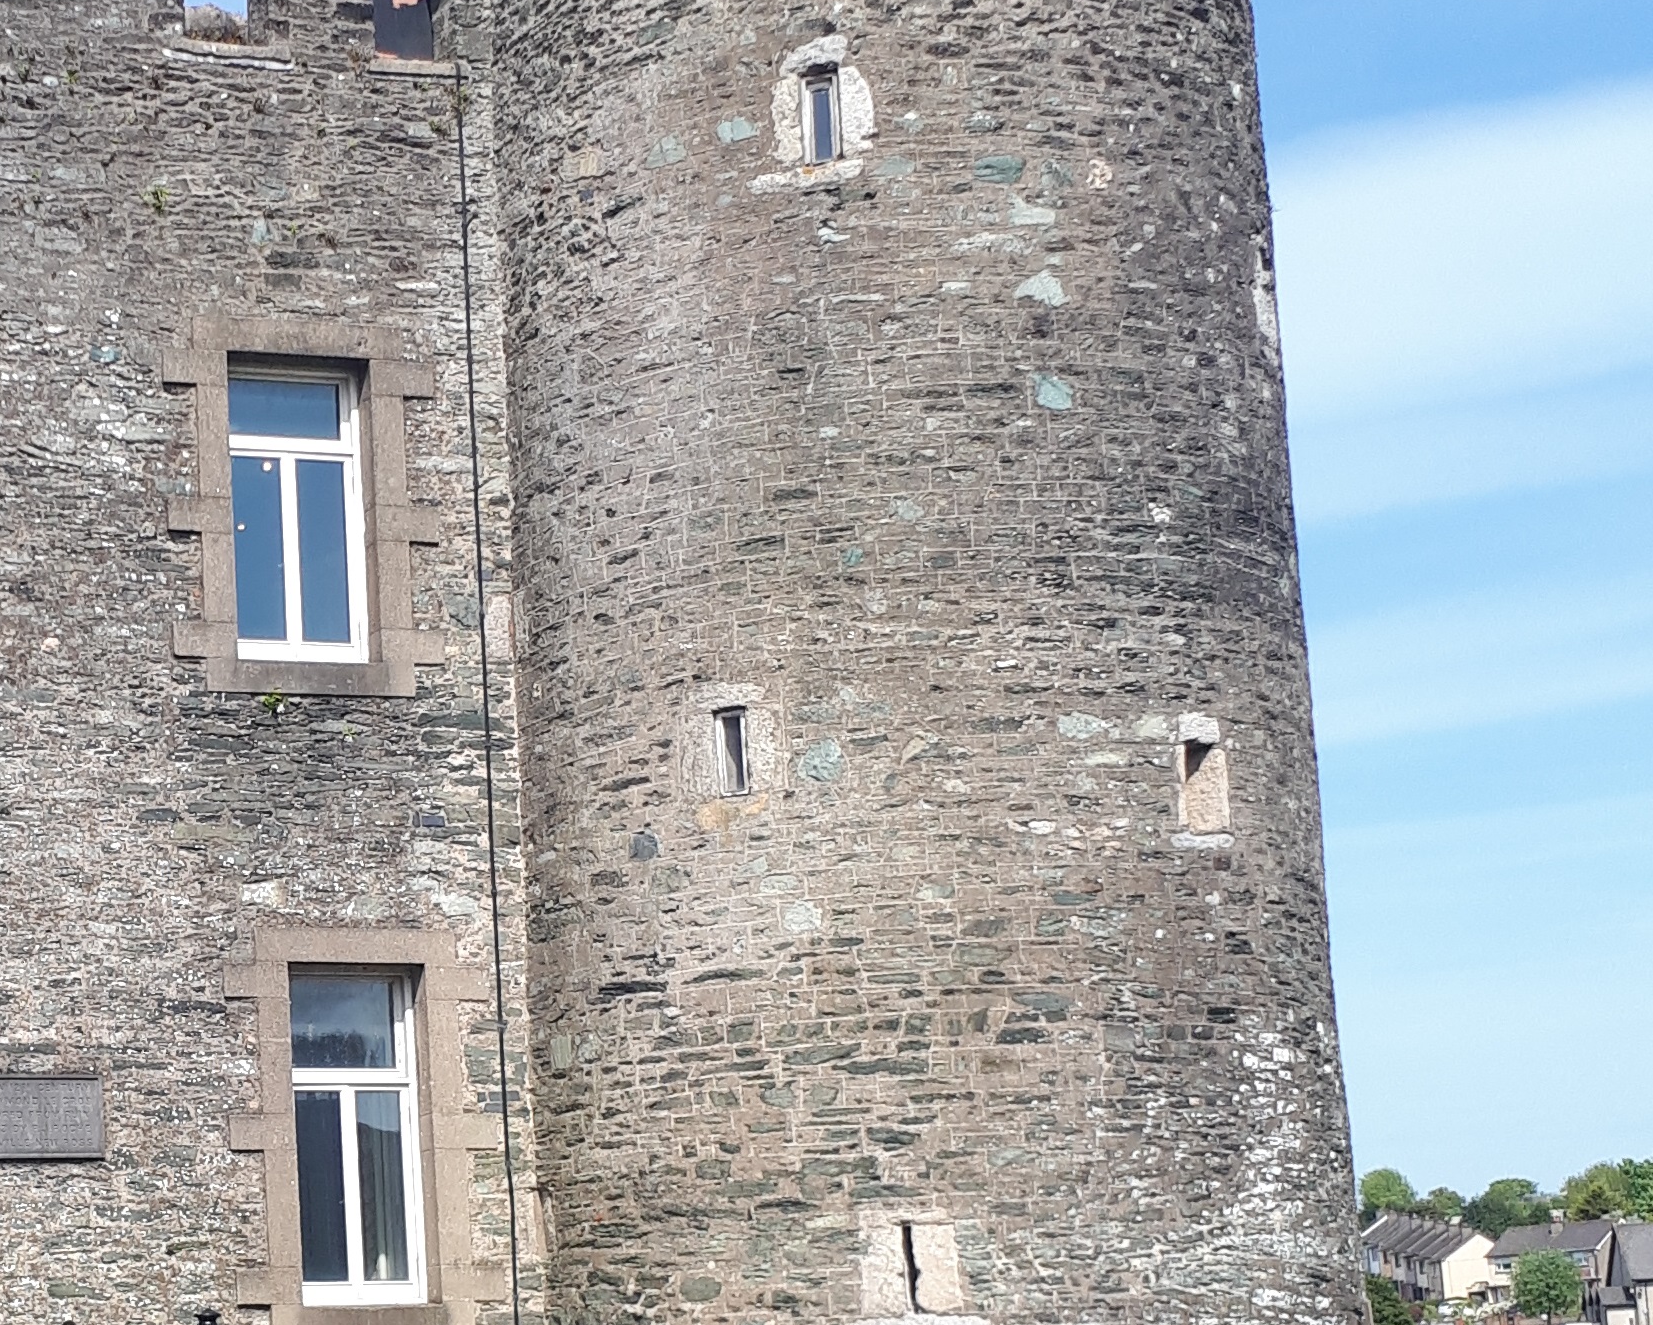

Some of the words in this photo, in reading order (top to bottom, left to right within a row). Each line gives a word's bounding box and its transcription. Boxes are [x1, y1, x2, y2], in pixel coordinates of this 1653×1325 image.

[37, 1081, 92, 1092] CENTURY
[28, 1109, 60, 1120] FROM
[34, 1137, 58, 1148] NEW
[63, 1137, 93, 1148] ROSS
